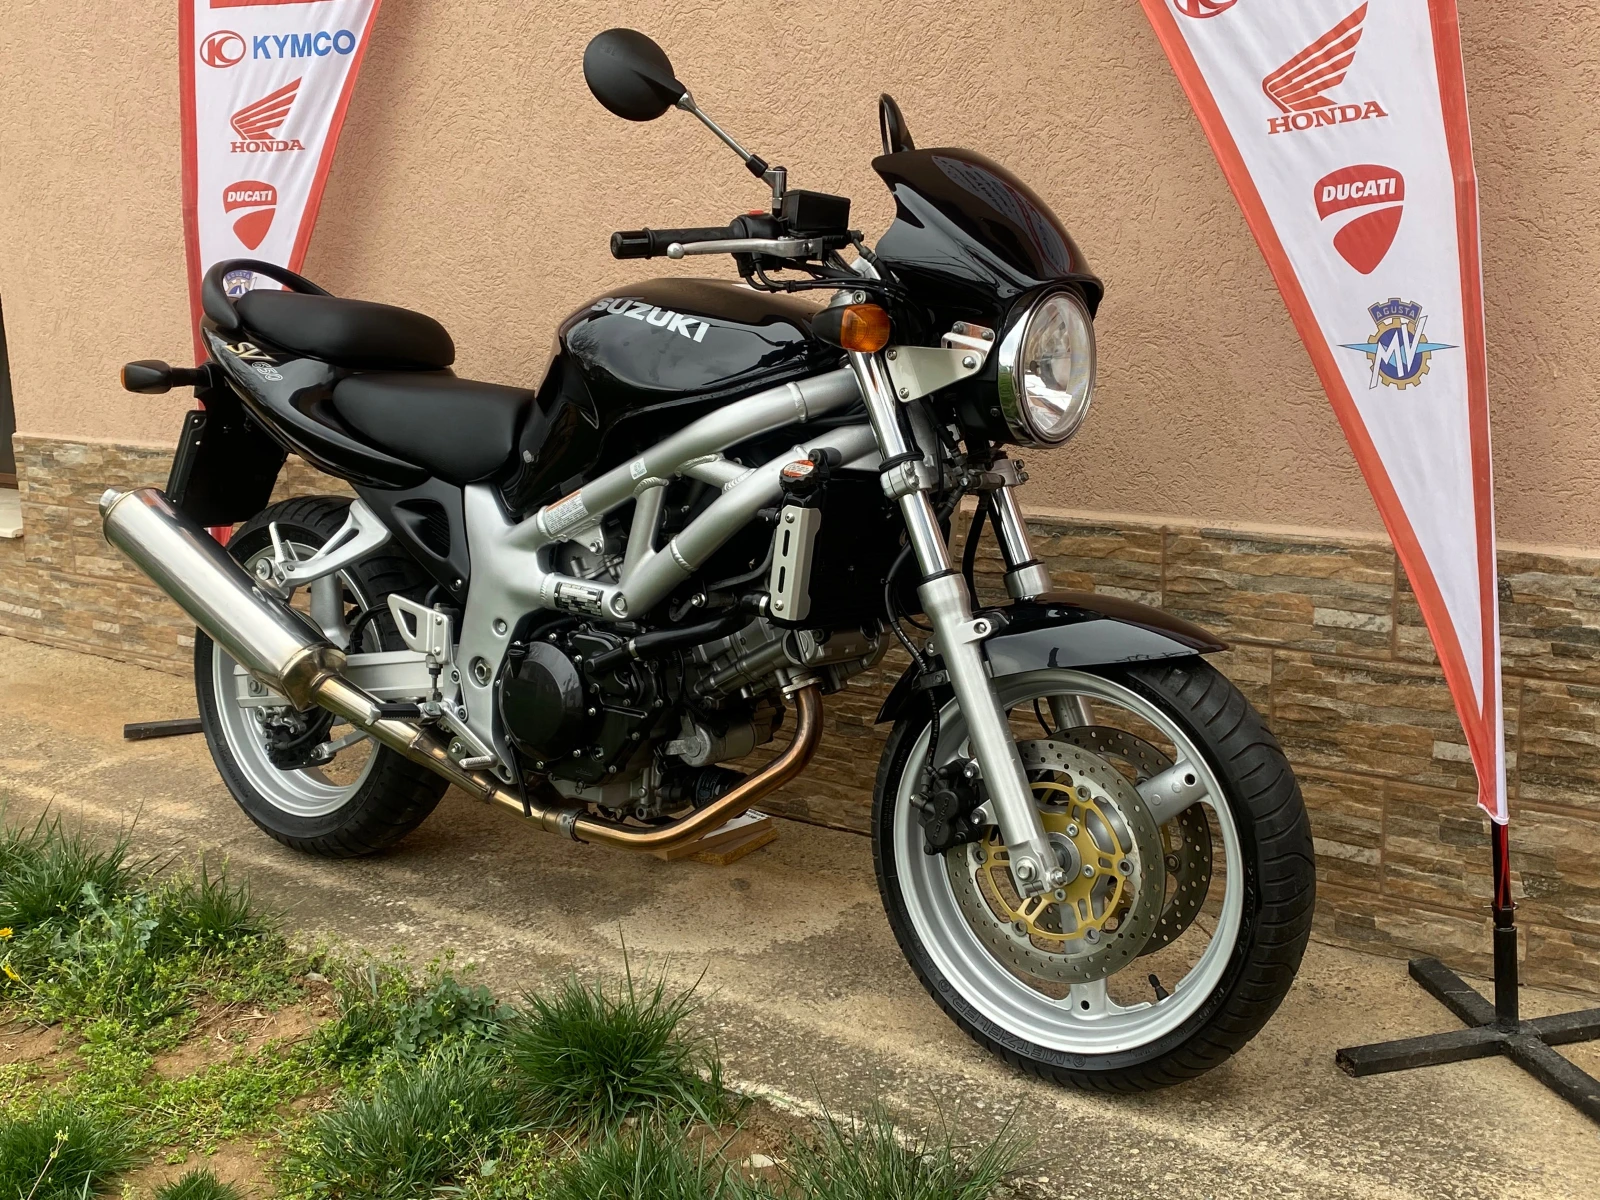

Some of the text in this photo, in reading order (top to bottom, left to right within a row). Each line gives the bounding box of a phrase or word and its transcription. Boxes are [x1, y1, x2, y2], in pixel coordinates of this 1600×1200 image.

[253, 30, 355, 59] KYMCO
[1267, 101, 1388, 134] HONDA
[230, 139, 305, 153] HONDA
[227, 190, 272, 202] DUCATI
[1322, 178, 1396, 202] DUCATI
[591, 297, 710, 343] SUZUKI
[1376, 306, 1415, 319] AGUSTA
[224, 341, 278, 362] SV
[1369, 315, 1428, 390] MV
[952, 995, 1066, 1067] METZELER
